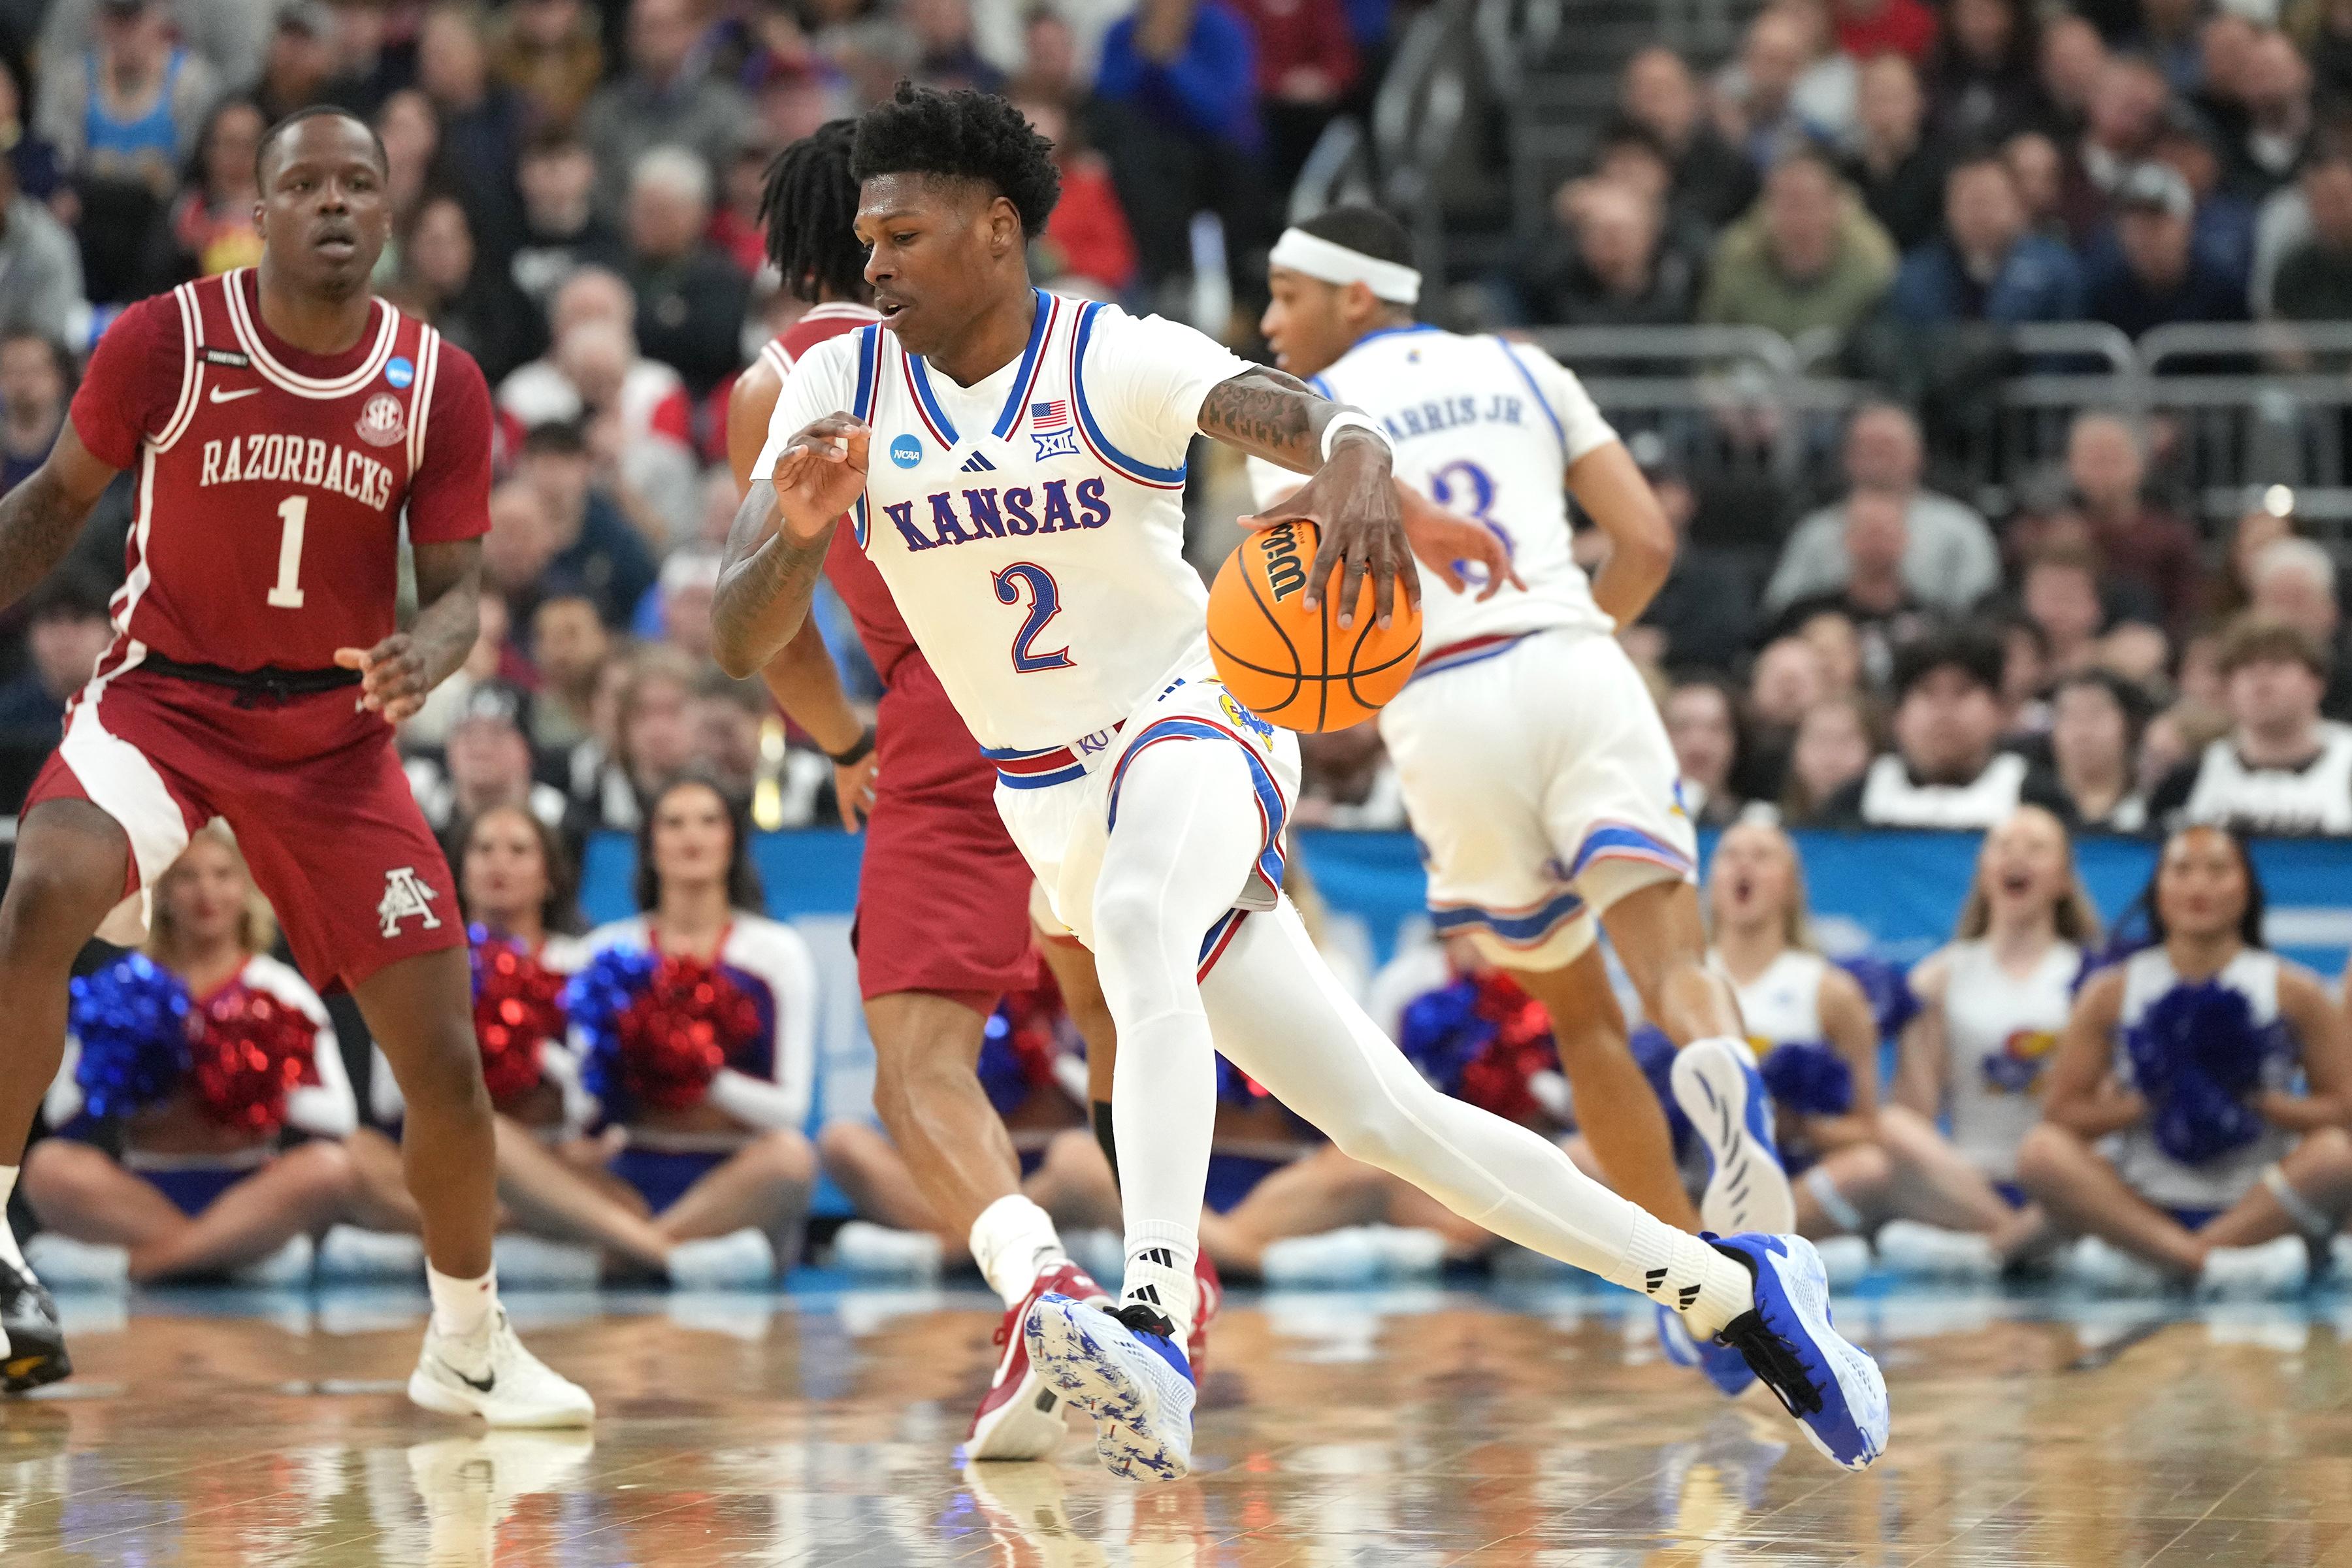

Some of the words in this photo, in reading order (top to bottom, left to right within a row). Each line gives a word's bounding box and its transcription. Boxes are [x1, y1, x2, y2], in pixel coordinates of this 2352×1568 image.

[366, 397, 401, 431] SEC
[1383, 396, 1477, 440] ARRIS
[200, 434, 393, 512] RAZORBACKS
[894, 449, 920, 461] NCAA
[267, 495, 308, 609] 1
[883, 476, 1112, 552] KANSAS
[1260, 523, 1307, 603] Wils
[990, 562, 1077, 674] 2
[1076, 730, 1109, 756] KU
